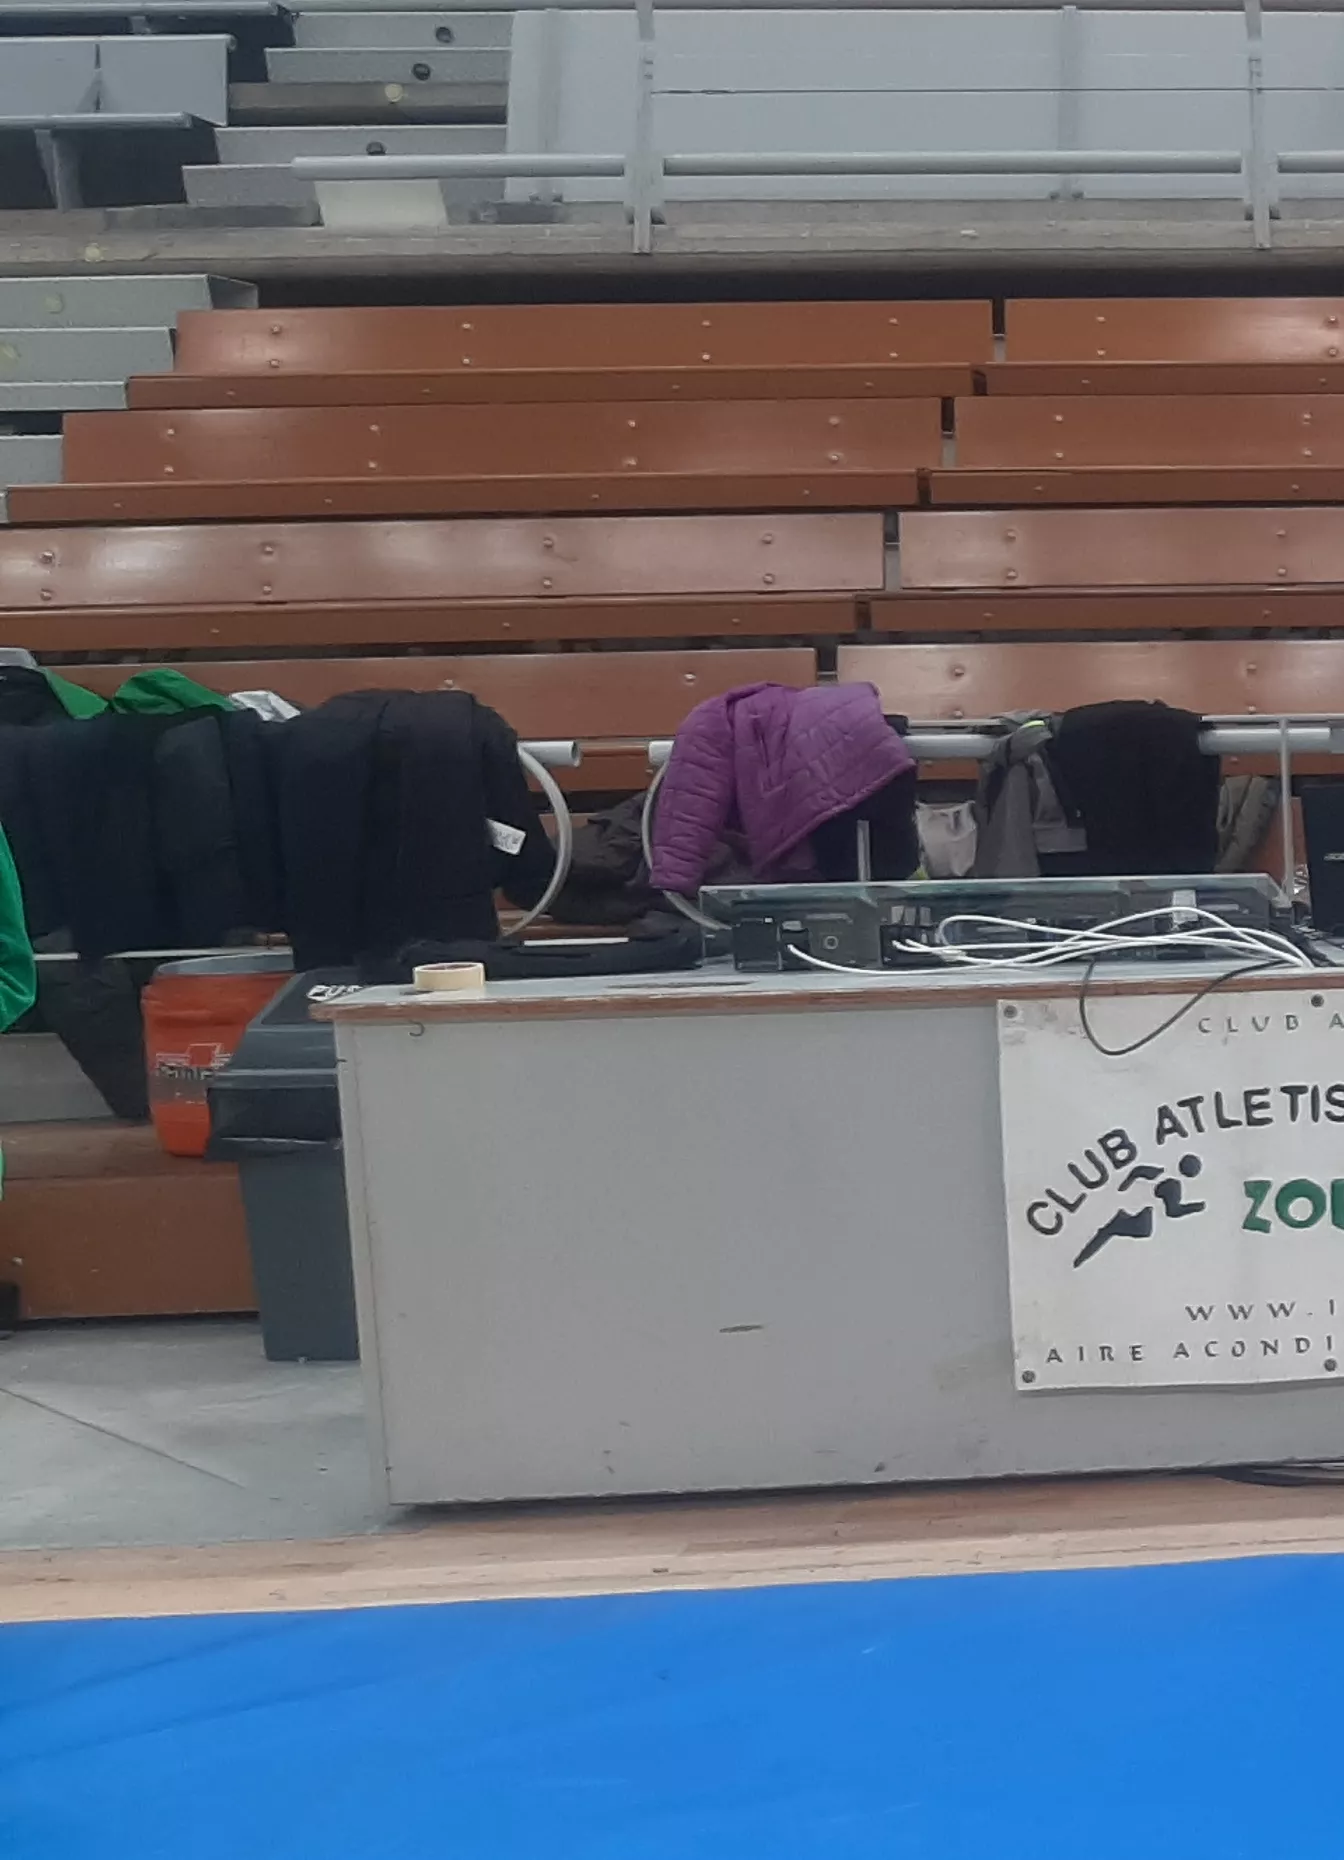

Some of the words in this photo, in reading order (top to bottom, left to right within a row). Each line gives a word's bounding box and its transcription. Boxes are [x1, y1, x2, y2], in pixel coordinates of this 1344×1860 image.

[1197, 1013, 1300, 1034] CLUB
[1026, 1128, 1137, 1236] CLUB
[1046, 1345, 1144, 1364] AIRE
